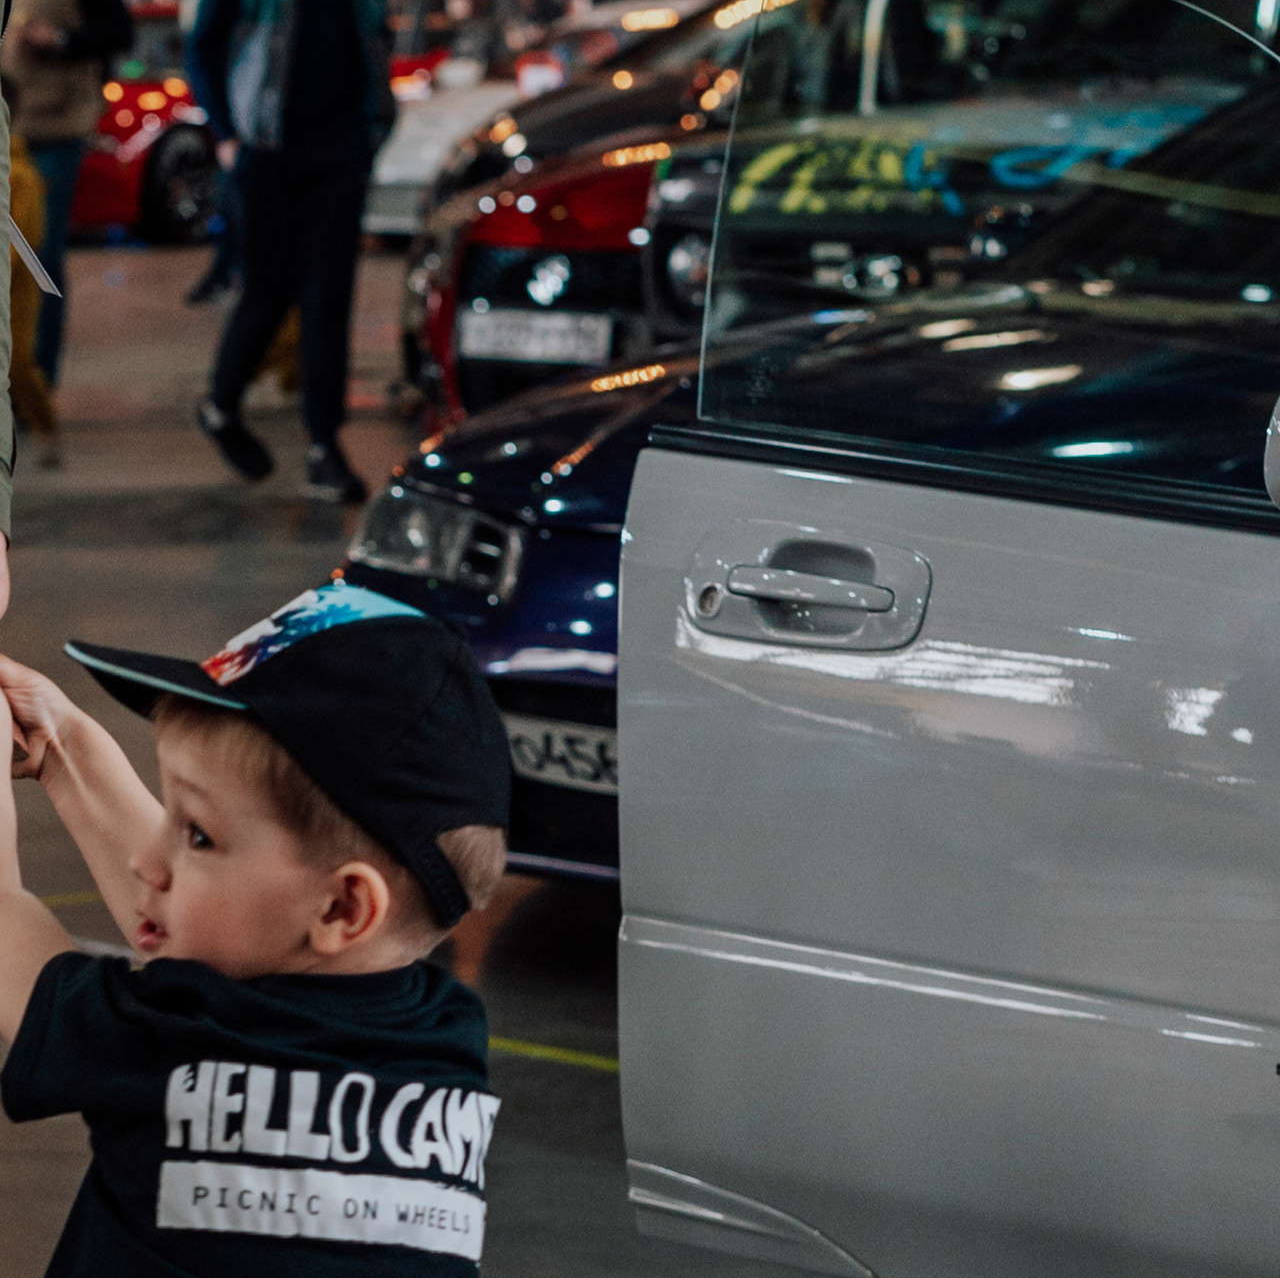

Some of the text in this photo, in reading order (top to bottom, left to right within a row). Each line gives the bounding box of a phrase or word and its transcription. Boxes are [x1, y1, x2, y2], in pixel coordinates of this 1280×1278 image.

[165, 1058, 376, 1163] HELLO
[192, 1186, 321, 1216] PICNIC
[343, 1198, 378, 1220] ON
